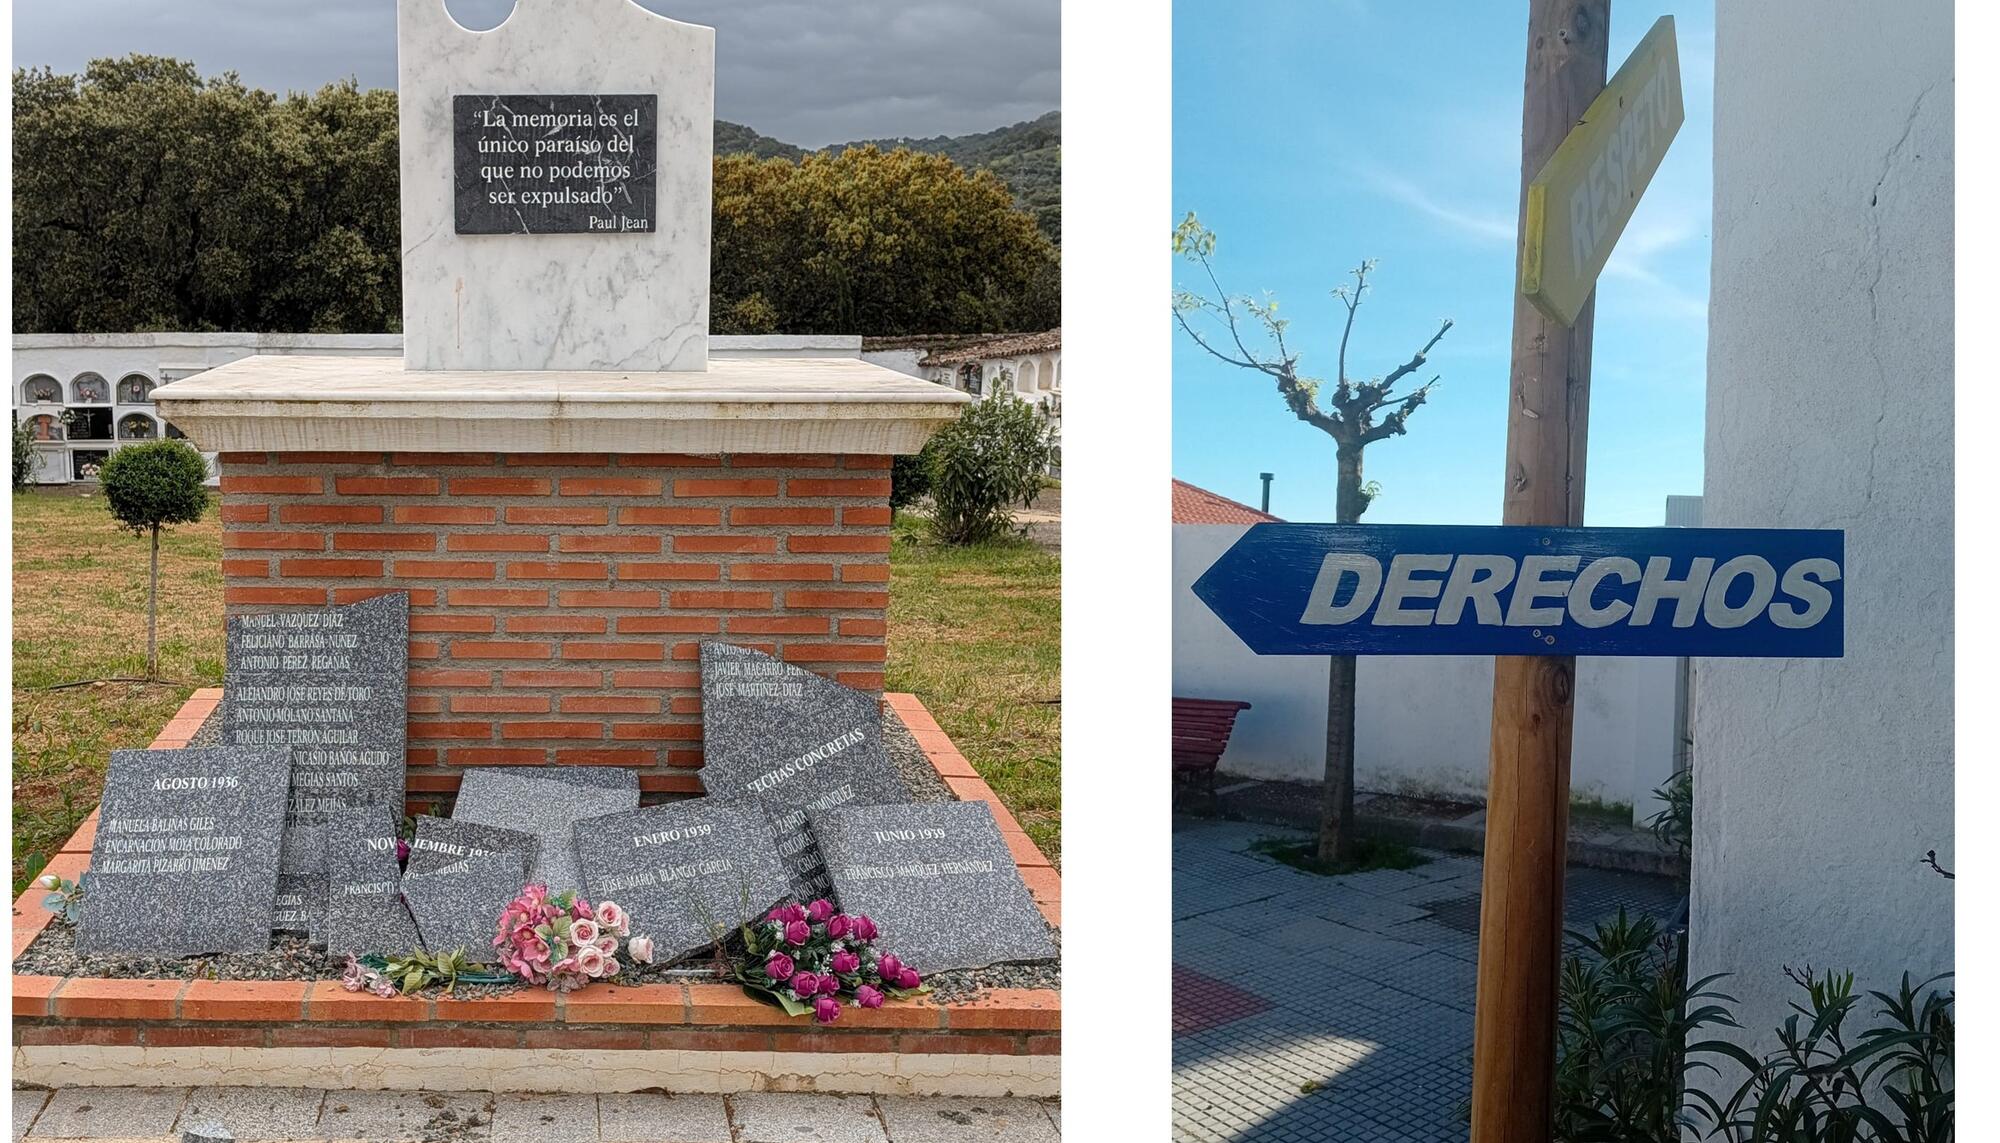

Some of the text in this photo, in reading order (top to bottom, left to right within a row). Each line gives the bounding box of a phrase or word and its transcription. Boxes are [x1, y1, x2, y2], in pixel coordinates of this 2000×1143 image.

[512, 109, 593, 127] memoria
[599, 113, 617, 127] es
[623, 109, 638, 127] el
[478, 135, 634, 157] único paraíso del
[481, 161, 631, 182] que no podemos
[1570, 57, 1670, 280] RESPETO
[488, 187, 622, 208] ser expulsado”
[589, 216, 648, 232] Paul Jean
[1300, 554, 1841, 629] DERECHOS
[241, 614, 276, 628] MANUEL
[241, 634, 285, 648] FELICIANO
[241, 655, 279, 670] ANTONIO
[714, 661, 740, 678] JAVIER
[237, 686, 285, 702] ALEJANDRO
[307, 687, 333, 701] REYES
[348, 687, 371, 701] TORO
[236, 708, 274, 722] ANTONIO
[235, 730, 265, 745] ROQUE
[321, 730, 359, 745] AGUILAR
[358, 750, 390, 766] AGUDO
[794, 727, 865, 772] CONCRETAS
[151, 776, 239, 790] AGOSTO 1936
[325, 772, 359, 787] SANTOS
[109, 818, 149, 833] MANUELA
[190, 816, 216, 831] GILES
[779, 809, 808, 834] ZAPATA
[194, 836, 242, 851] COLORADO
[633, 824, 711, 848] ENERO 1939
[874, 828, 946, 843] JUNIO 1939
[101, 859, 151, 879] MARGARITA
[153, 857, 191, 874] PIZARRO
[659, 864, 697, 882] BLANCO
[845, 863, 894, 881] FRANCISCO
